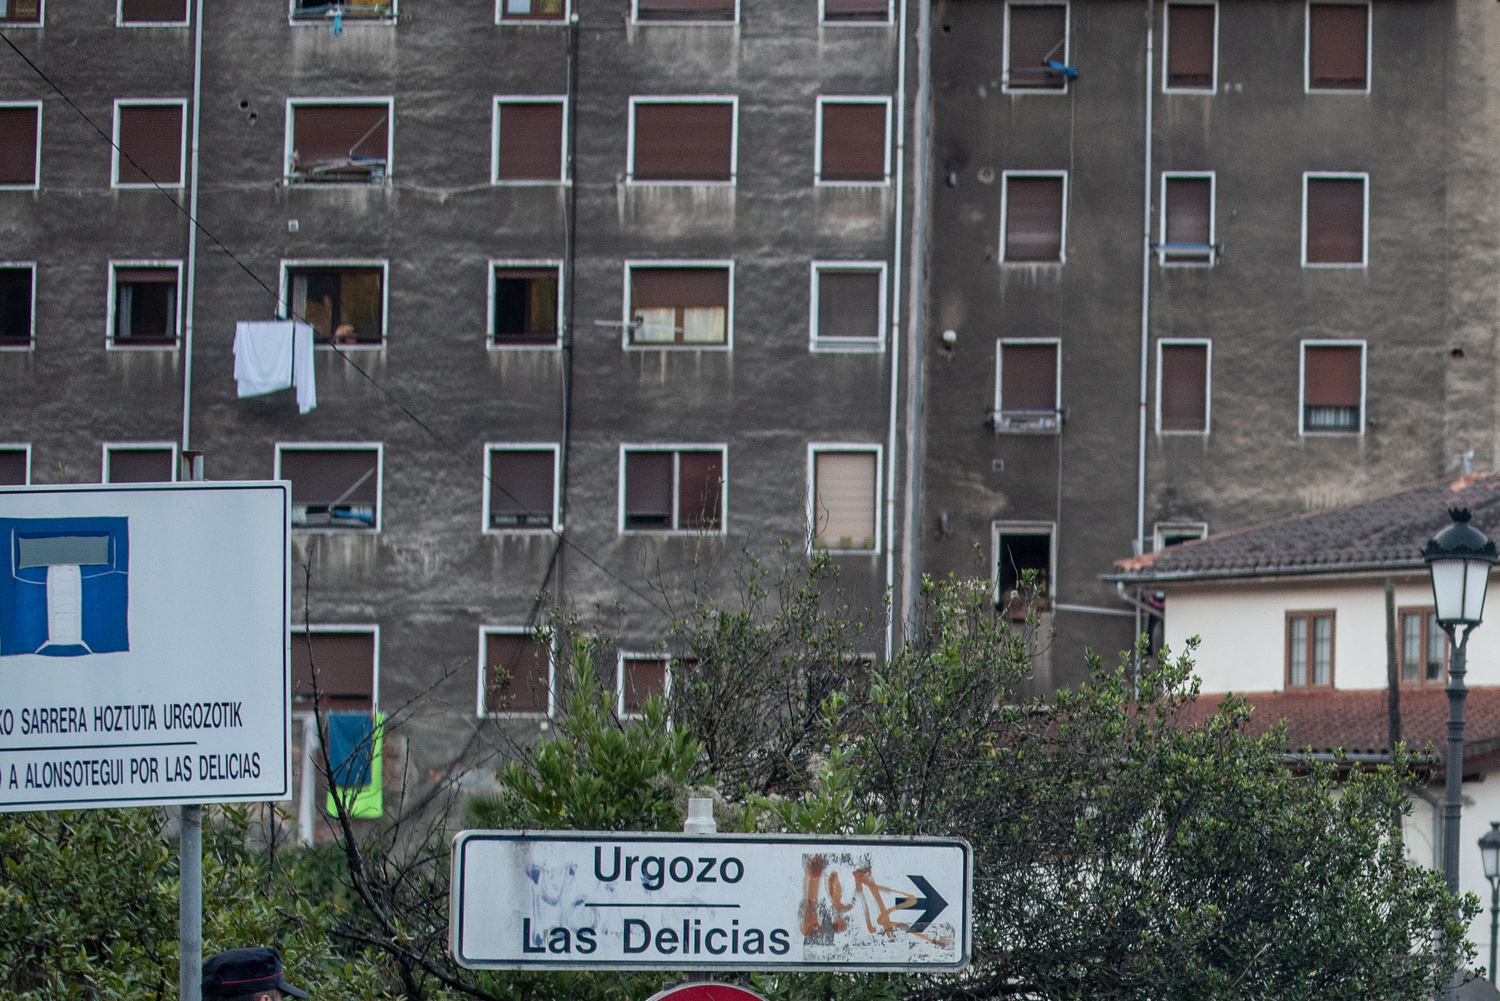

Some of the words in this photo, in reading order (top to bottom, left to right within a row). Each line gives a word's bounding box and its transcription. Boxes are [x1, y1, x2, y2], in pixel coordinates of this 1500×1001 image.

[21, 706, 88, 735] SARRERA
[94, 704, 157, 732] HOZTUTA
[164, 702, 243, 730] URGOZOTIK
[9, 763, 19, 790] A
[25, 758, 124, 789] ALONSOTEGUI
[130, 757, 159, 784] POR
[165, 754, 192, 783] LAS
[199, 751, 261, 781] DELICIAS
[593, 846, 745, 891] Urgozo
[522, 917, 598, 955] Las
[622, 917, 791, 956] Delicias
